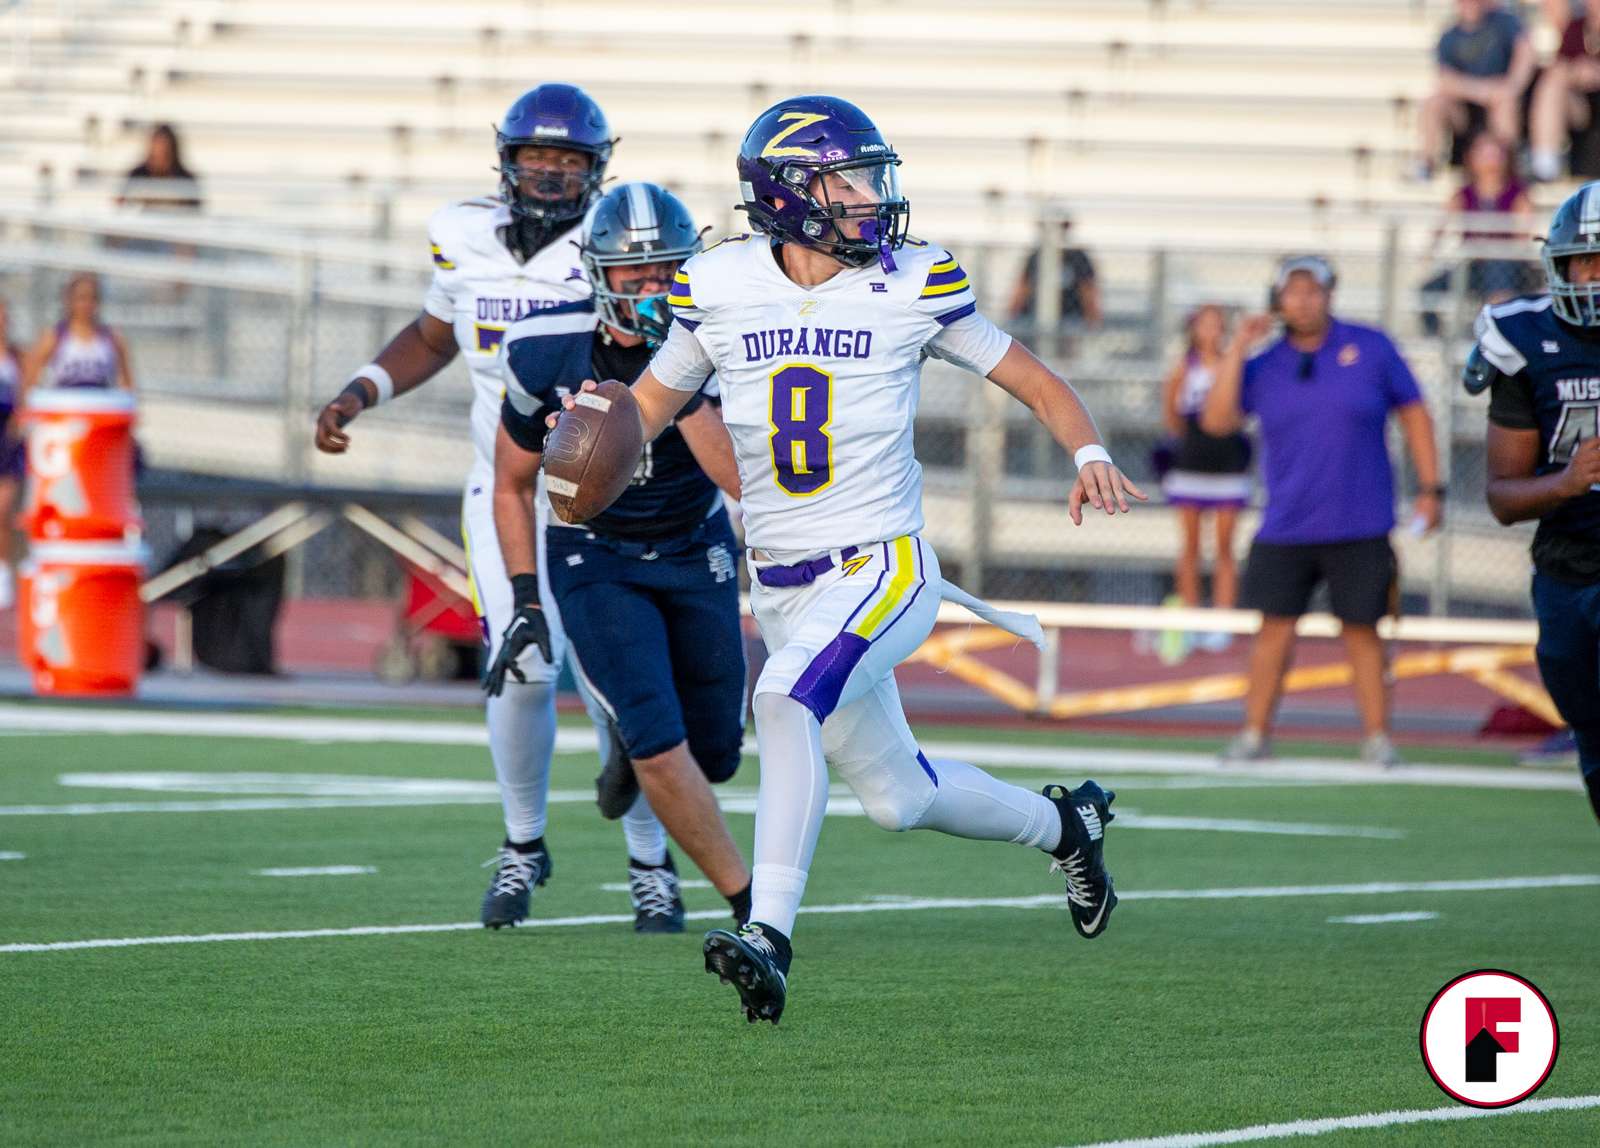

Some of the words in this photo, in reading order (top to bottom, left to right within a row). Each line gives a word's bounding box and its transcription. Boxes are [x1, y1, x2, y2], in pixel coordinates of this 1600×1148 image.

[760, 112, 830, 158] Z
[476, 297, 569, 321] DURAN
[742, 327, 873, 363] DURANGO
[768, 363, 834, 497] 8
[1076, 802, 1103, 841] NIKE
